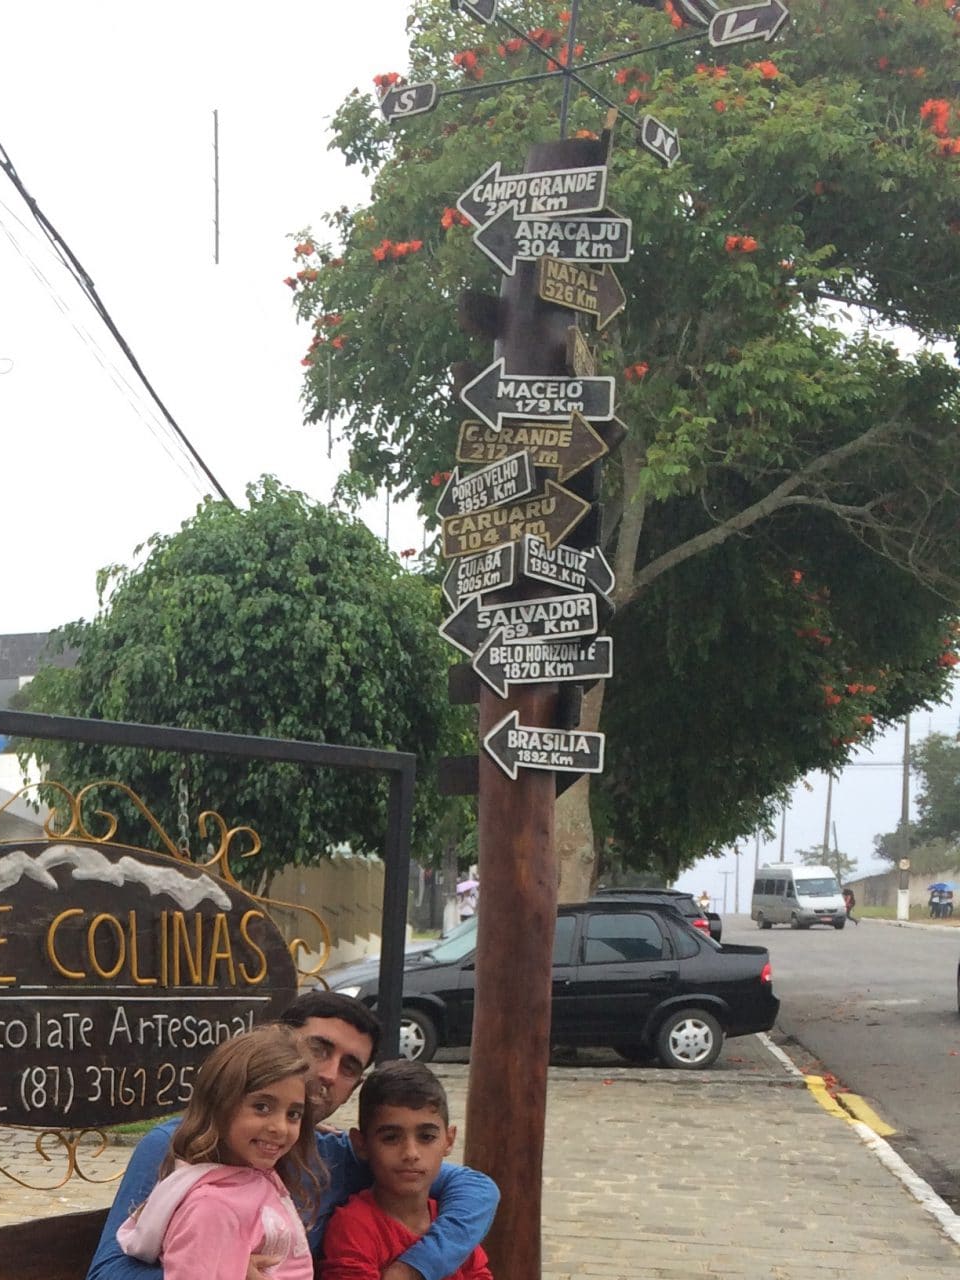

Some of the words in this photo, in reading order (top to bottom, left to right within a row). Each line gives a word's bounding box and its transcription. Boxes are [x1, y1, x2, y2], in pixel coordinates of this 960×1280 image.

[721, 13, 758, 41] L
[394, 89, 417, 113] S
[651, 127, 675, 157] N
[472, 179, 527, 202] CAMPO
[528, 172, 598, 196] GRANDE
[531, 196, 568, 212] Km
[517, 240, 560, 257] 304
[576, 241, 613, 258] Km
[547, 261, 598, 291] NATAL
[545, 280, 574, 304] 526
[577, 286, 597, 309] Km
[515, 399, 551, 412] 179
[554, 399, 584, 412] Km
[470, 443, 508, 459] 212
[452, 477, 485, 503] PORTO
[483, 459, 518, 488] VELHO
[458, 491, 488, 515] 3955
[447, 497, 556, 536] CARUARU
[458, 528, 500, 550] 104
[510, 519, 546, 541] Km
[530, 557, 557, 579] 1392
[557, 547, 587, 573] LUIZ
[456, 575, 482, 595] 3005
[483, 571, 500, 587] Km
[476, 599, 591, 629] SALVADOR
[489, 623, 529, 639] 69
[544, 619, 580, 634] Km
[489, 646, 523, 665] BELO
[503, 662, 540, 678] 1870
[544, 662, 574, 677] Km
[507, 730, 591, 754] BRASILIA
[517, 750, 548, 763] 1892
[551, 752, 574, 766] Km
[47, 908, 268, 986] COLINAS
[109, 1006, 254, 1048] Artesanal
[20, 1066, 74, 1114] (87)
[86, 1065, 147, 1106] 3761
[157, 1063, 202, 1106] 25
